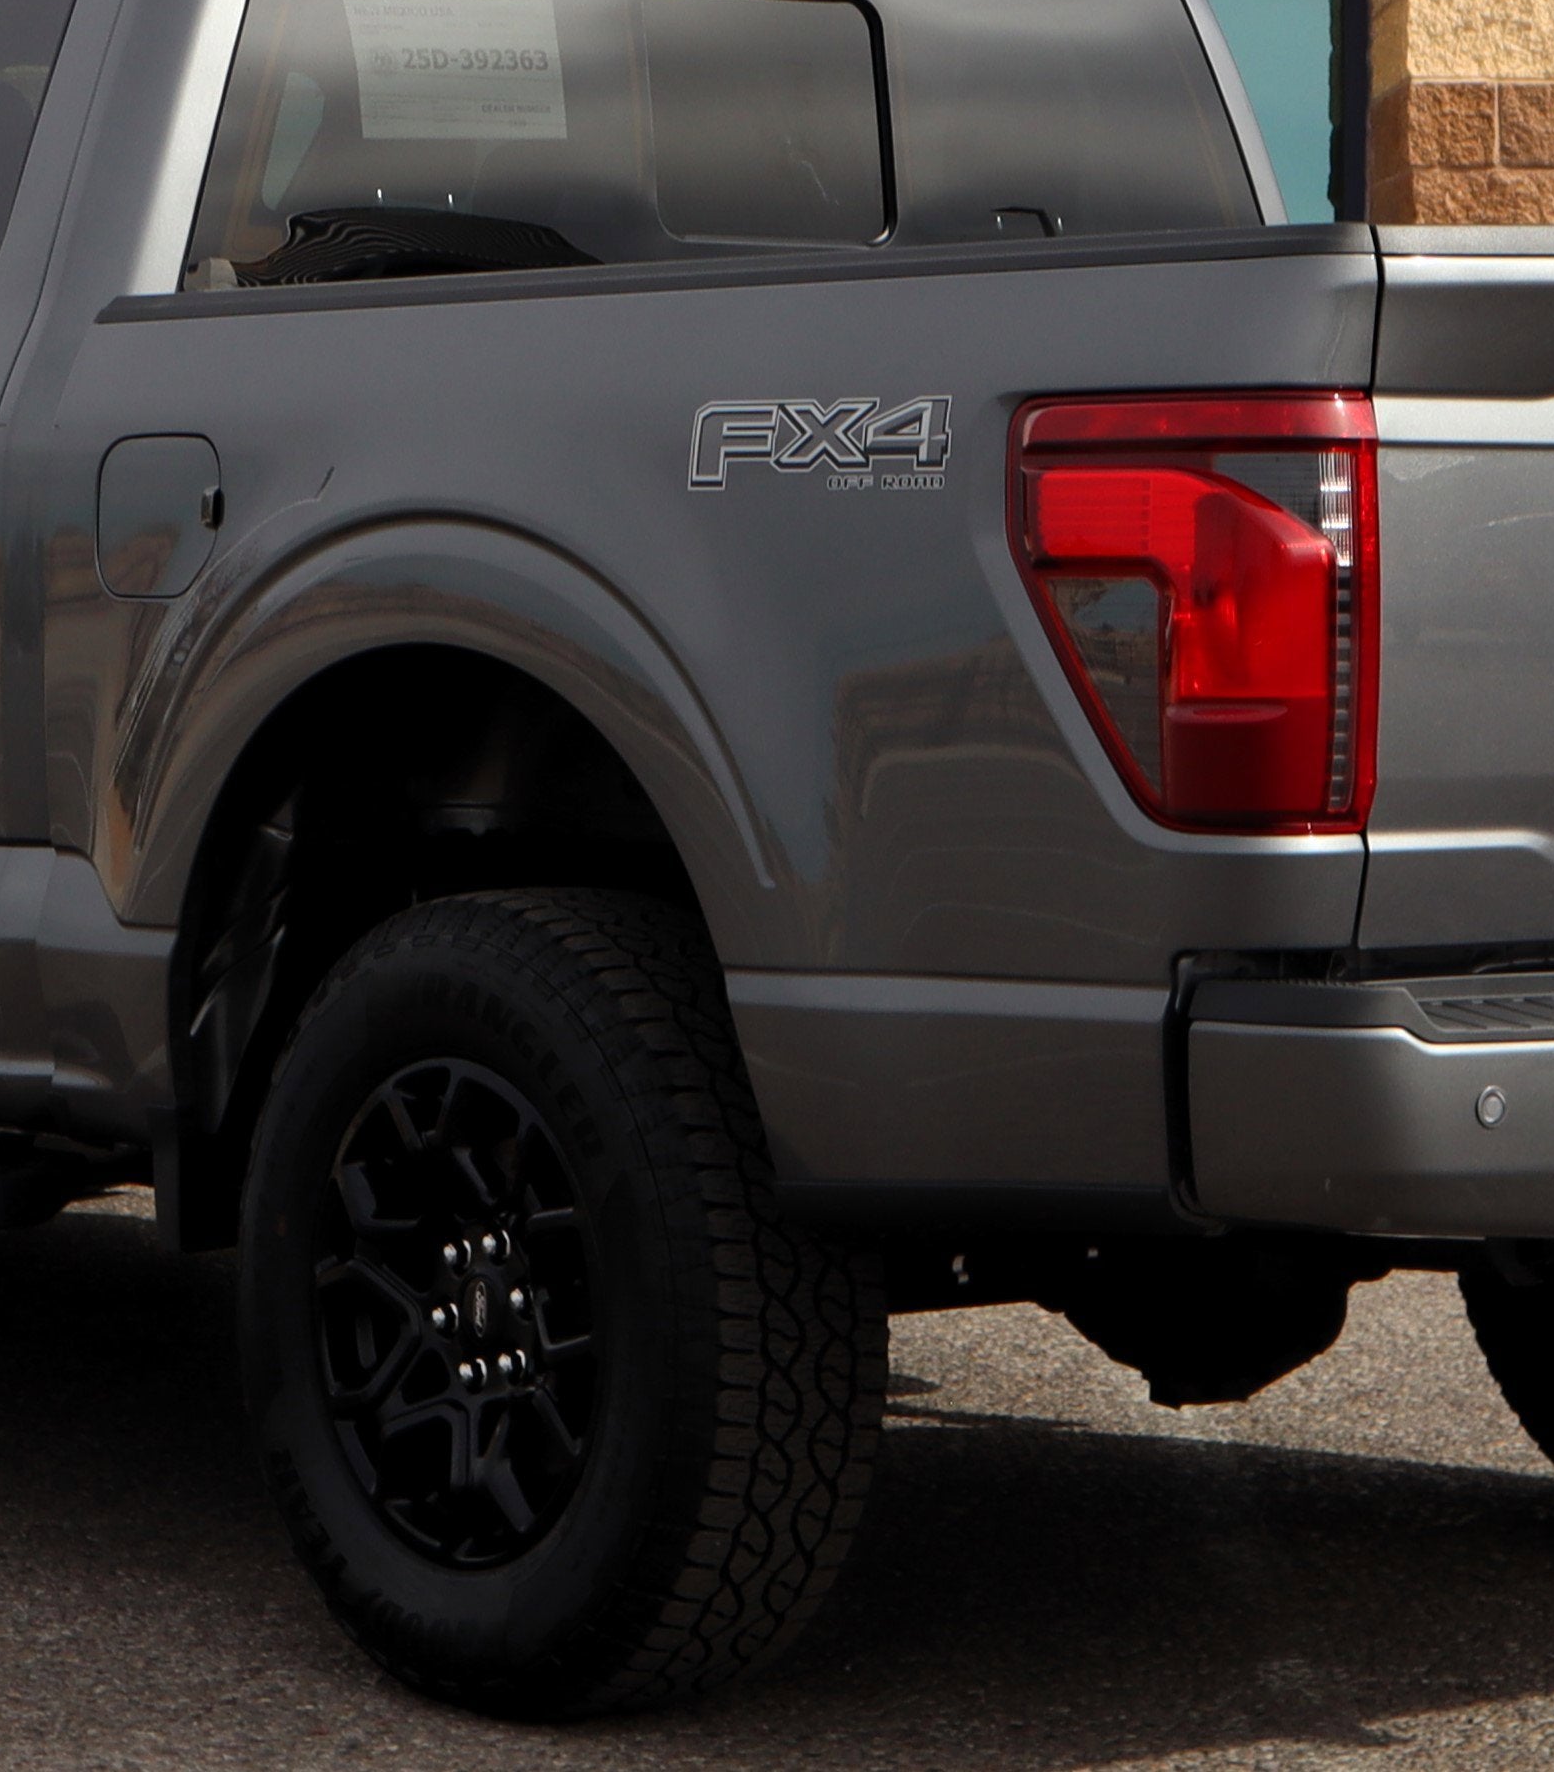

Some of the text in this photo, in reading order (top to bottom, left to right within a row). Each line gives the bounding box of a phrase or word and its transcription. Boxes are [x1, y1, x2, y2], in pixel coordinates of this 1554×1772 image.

[401, 48, 550, 72] 25D-392363
[688, 394, 953, 490] FX4
[826, 474, 946, 491] OFF ROAD
